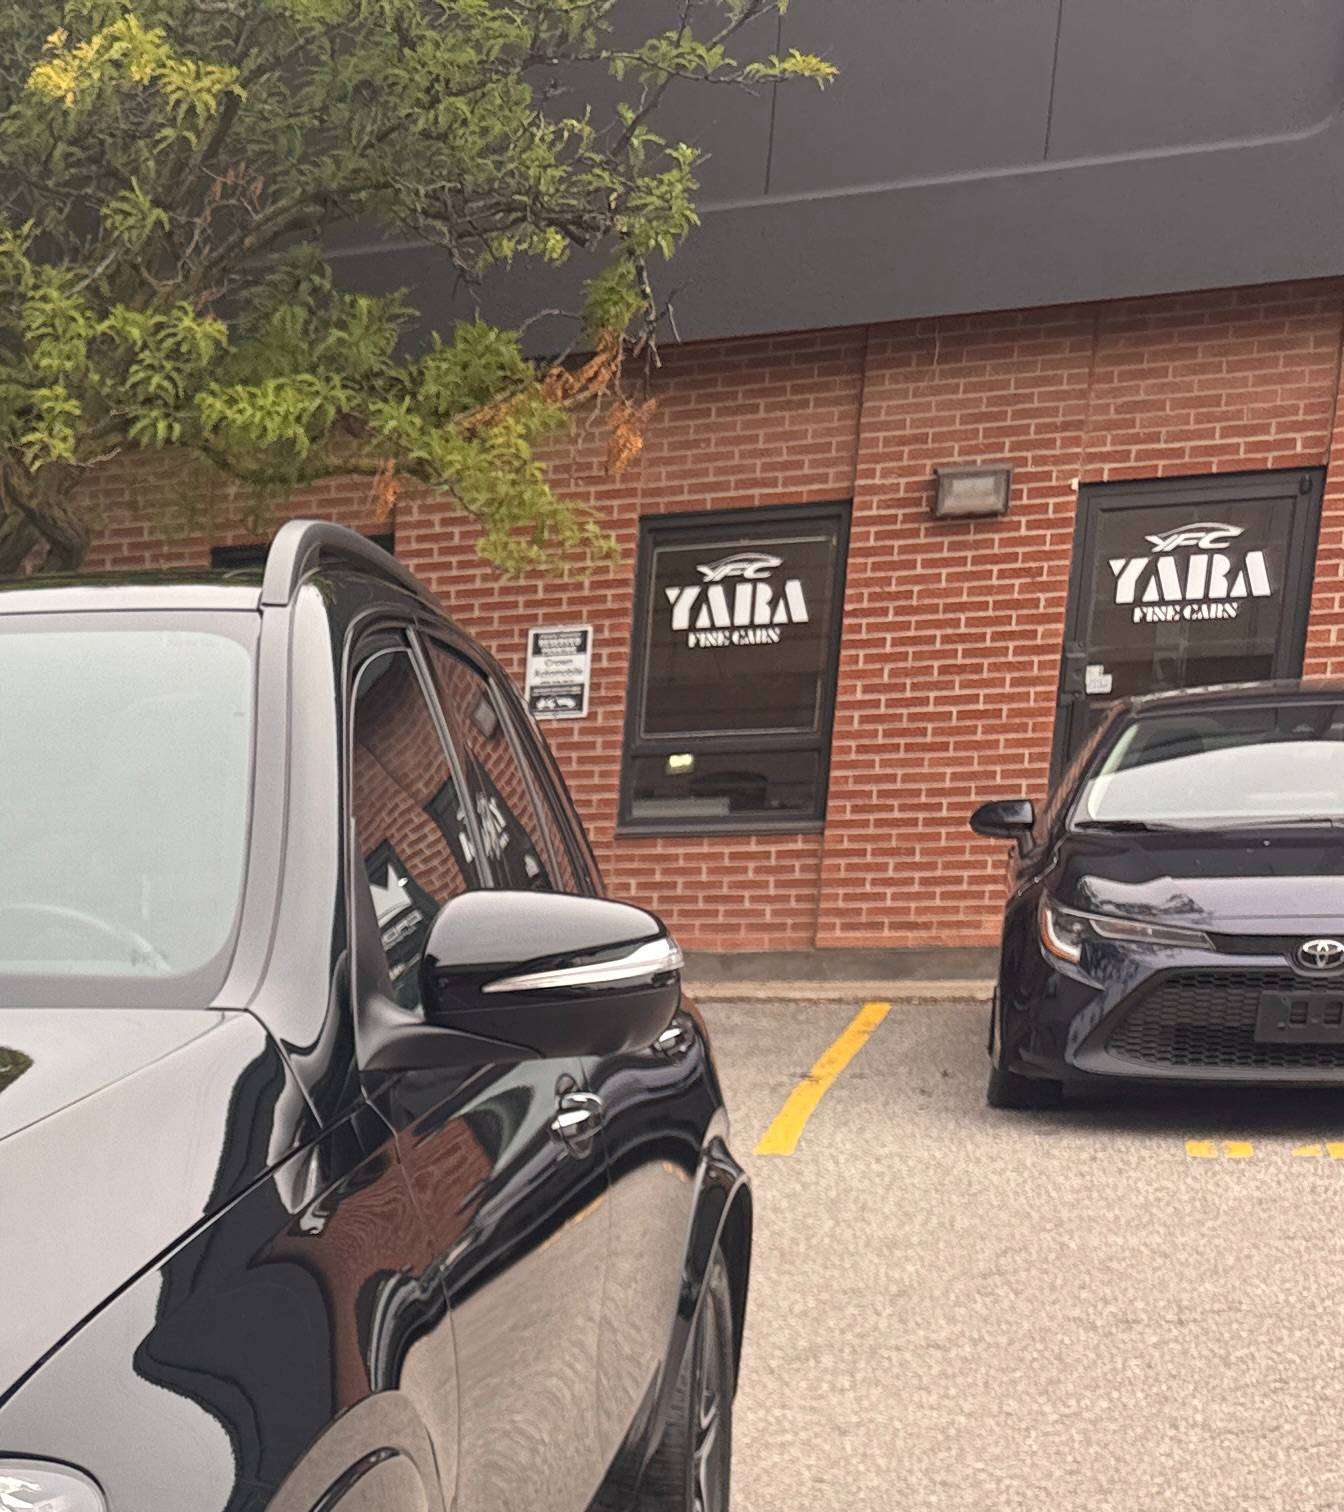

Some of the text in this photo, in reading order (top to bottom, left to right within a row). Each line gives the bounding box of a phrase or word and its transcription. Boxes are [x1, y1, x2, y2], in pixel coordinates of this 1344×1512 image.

[1108, 551, 1271, 604] YARA
[665, 579, 809, 631] YARA
[1132, 602, 1239, 623] FINE CARS
